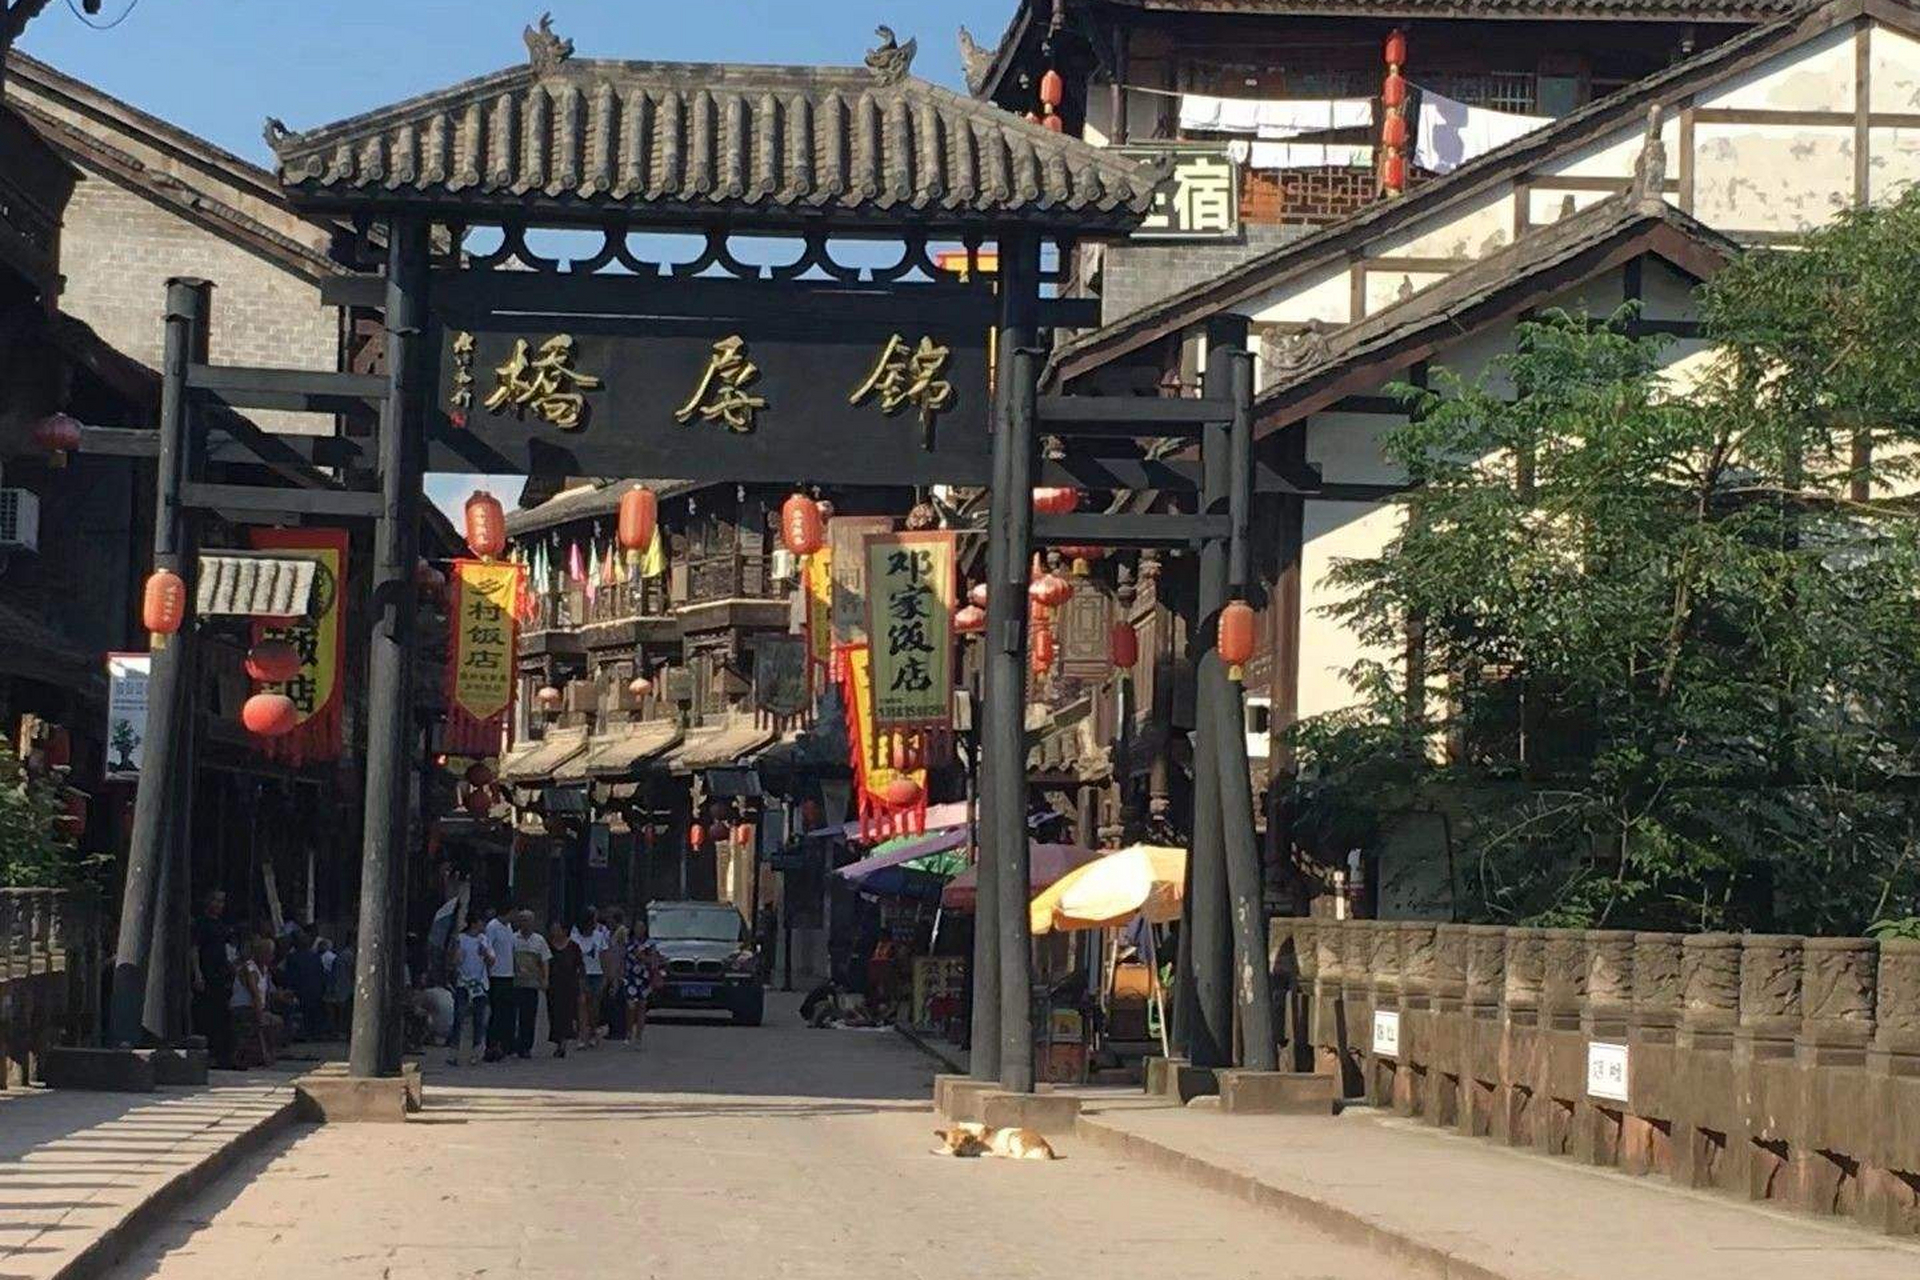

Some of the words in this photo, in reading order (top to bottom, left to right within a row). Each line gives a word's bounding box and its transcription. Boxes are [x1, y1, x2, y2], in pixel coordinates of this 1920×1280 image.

[464, 577, 506, 670] 乡村饭店
[886, 549, 935, 693] 邓家饭店
